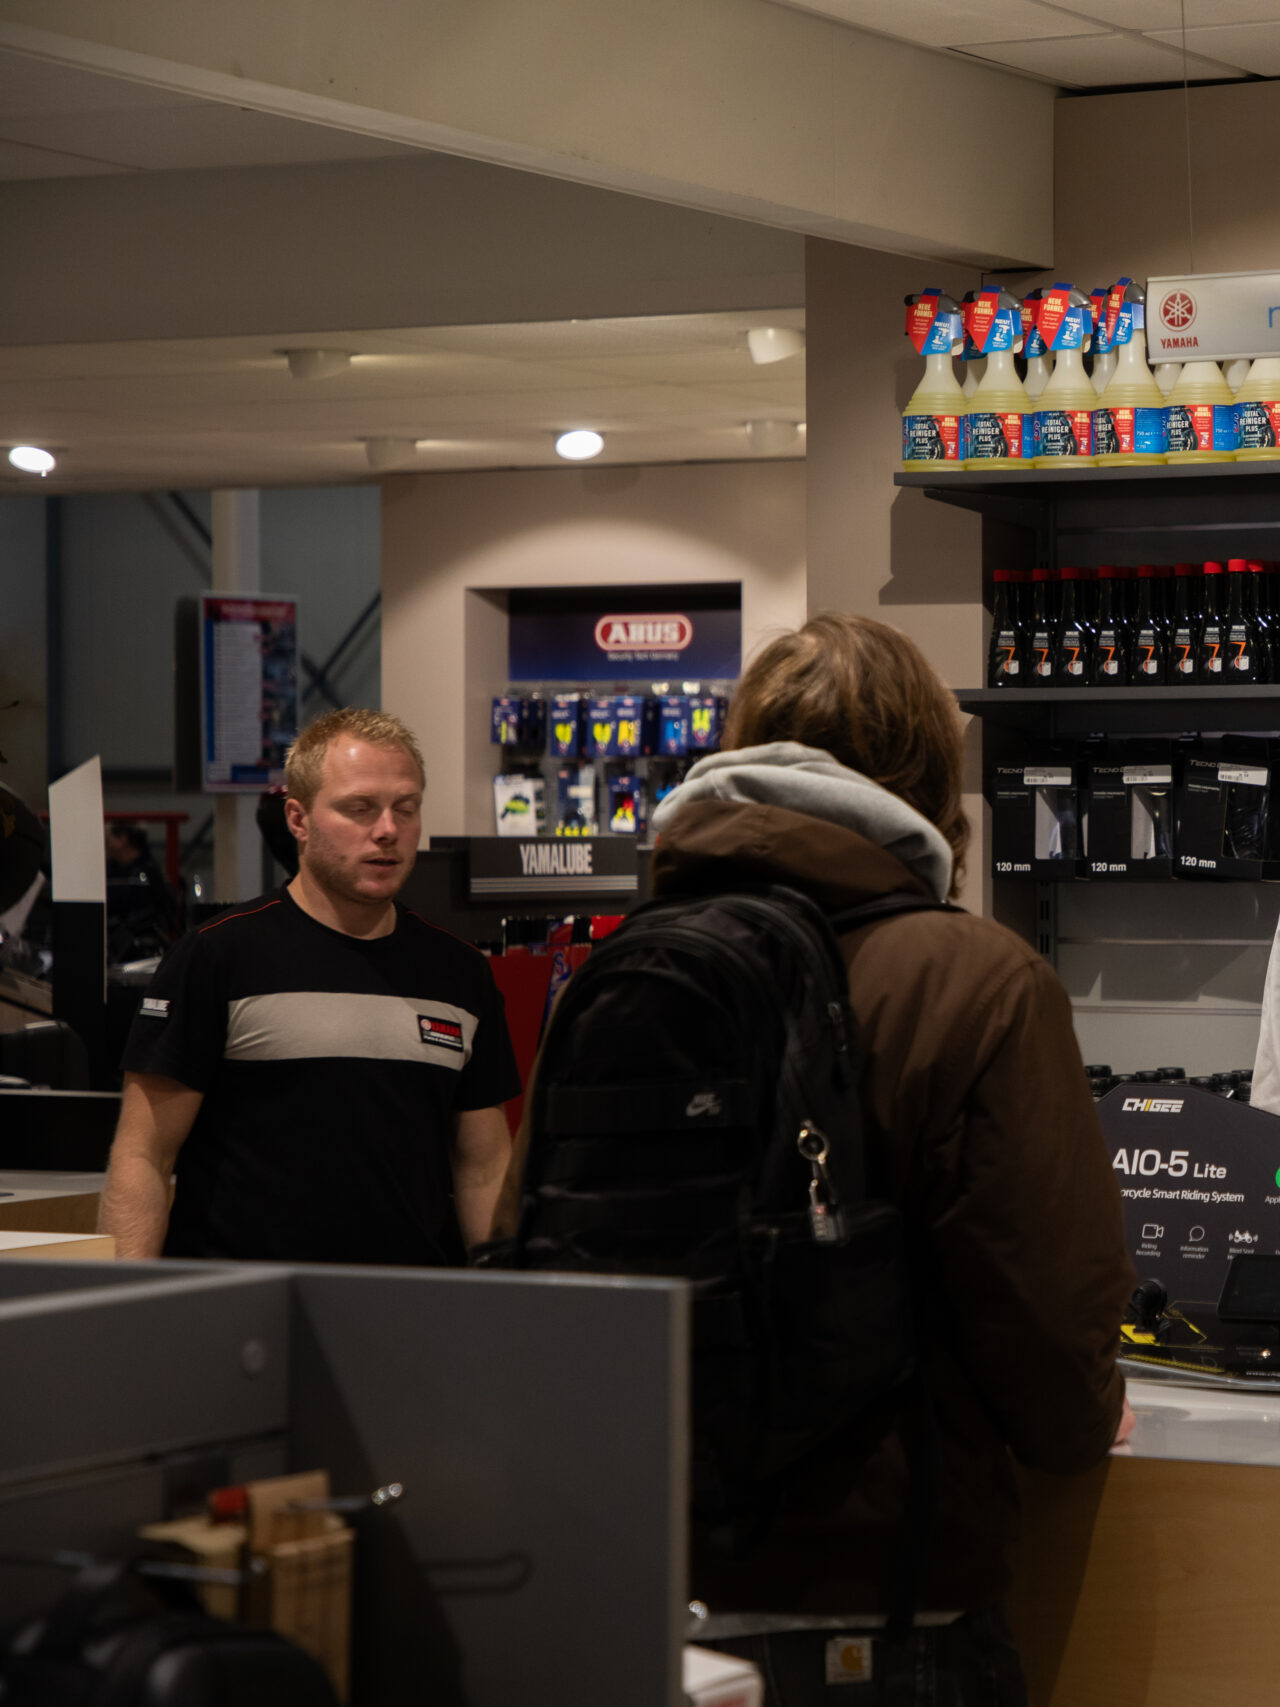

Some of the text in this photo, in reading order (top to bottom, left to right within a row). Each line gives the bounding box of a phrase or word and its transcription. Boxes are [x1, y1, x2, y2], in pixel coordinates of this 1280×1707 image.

[1160, 336, 1199, 349] YAMAHA
[607, 622, 679, 643] ABUS
[520, 843, 593, 875] YAMALUBE
[996, 862, 1012, 871] 120
[1091, 862, 1108, 871] 120
[1180, 856, 1216, 868] 120 mm
[1122, 1098, 1185, 1113] CHIGEE
[1112, 1148, 1227, 1179] AIO-5 Lite
[1121, 1187, 1245, 1204] orcycle Smart Riding System
